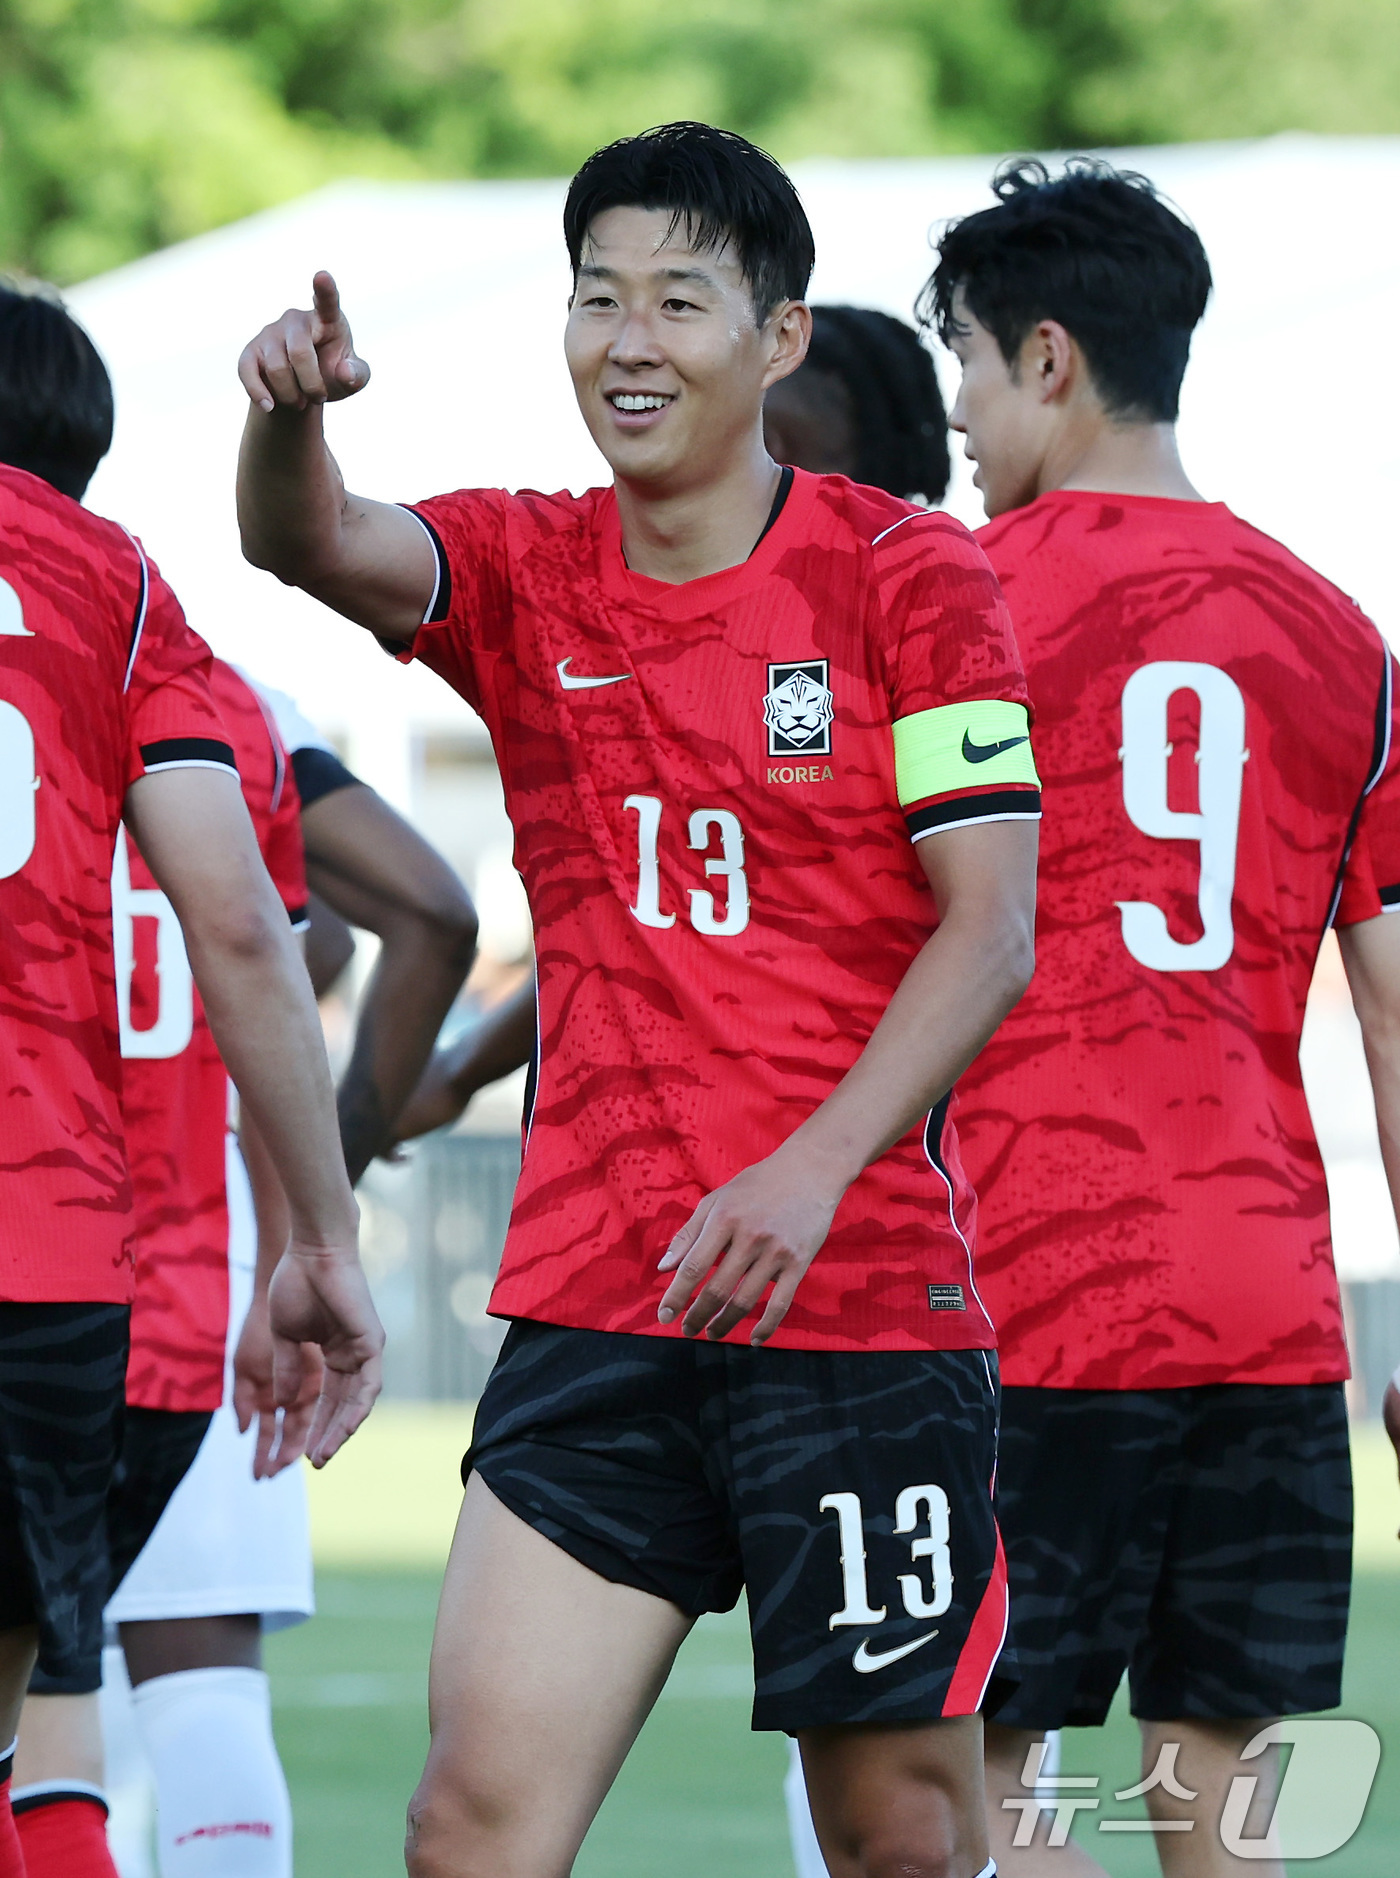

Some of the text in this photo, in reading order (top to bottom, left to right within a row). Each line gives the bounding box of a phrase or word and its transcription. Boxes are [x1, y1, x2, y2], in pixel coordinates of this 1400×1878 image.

[766, 765, 834, 784] KOREA
[1113, 660, 1250, 971] 9
[623, 794, 751, 936] 13
[819, 1483, 954, 1631] 13
